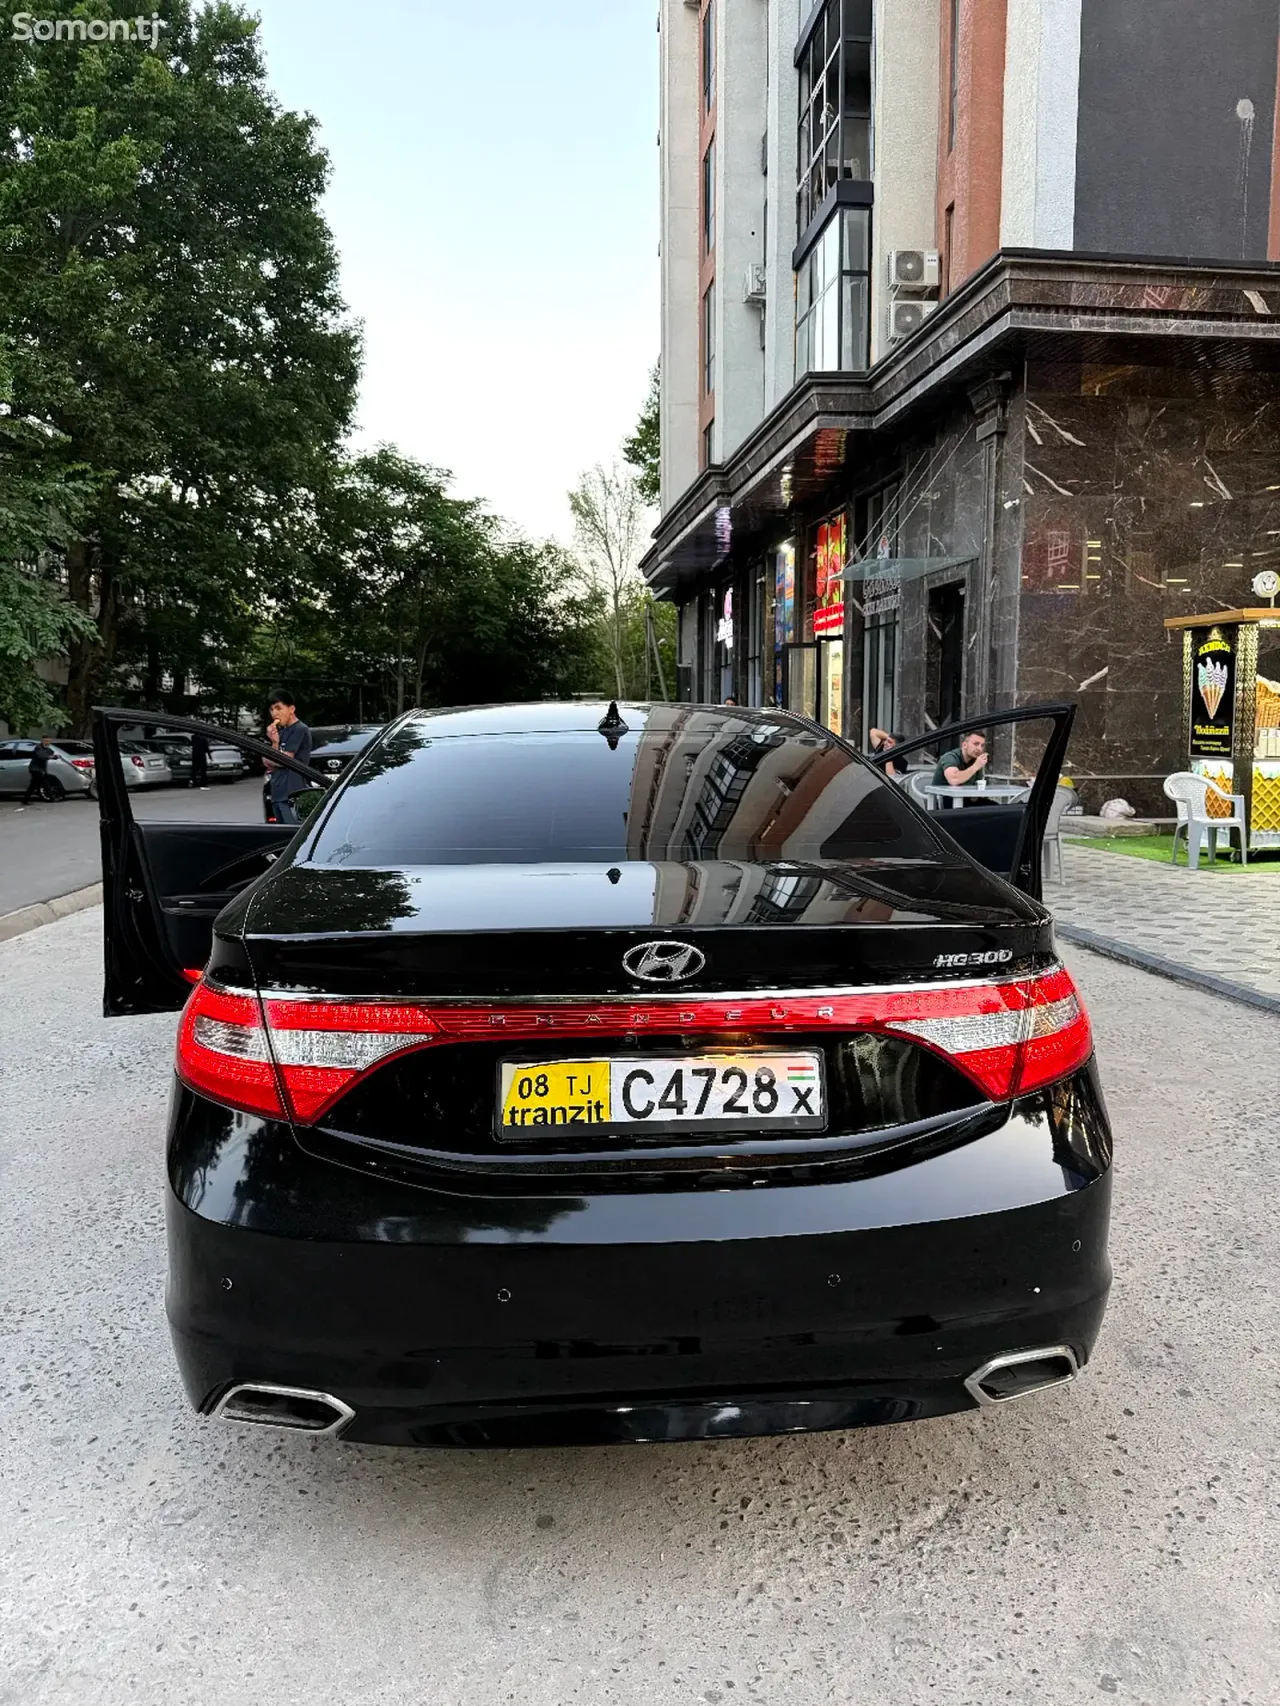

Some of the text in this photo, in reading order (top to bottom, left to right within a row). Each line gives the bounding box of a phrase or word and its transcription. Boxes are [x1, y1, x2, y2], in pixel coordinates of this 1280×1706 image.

[933, 949, 1013, 967] HG300
[518, 1074, 592, 1099] 08 TJ
[622, 1066, 779, 1119] C4728
[509, 1100, 604, 1125] tranzit
